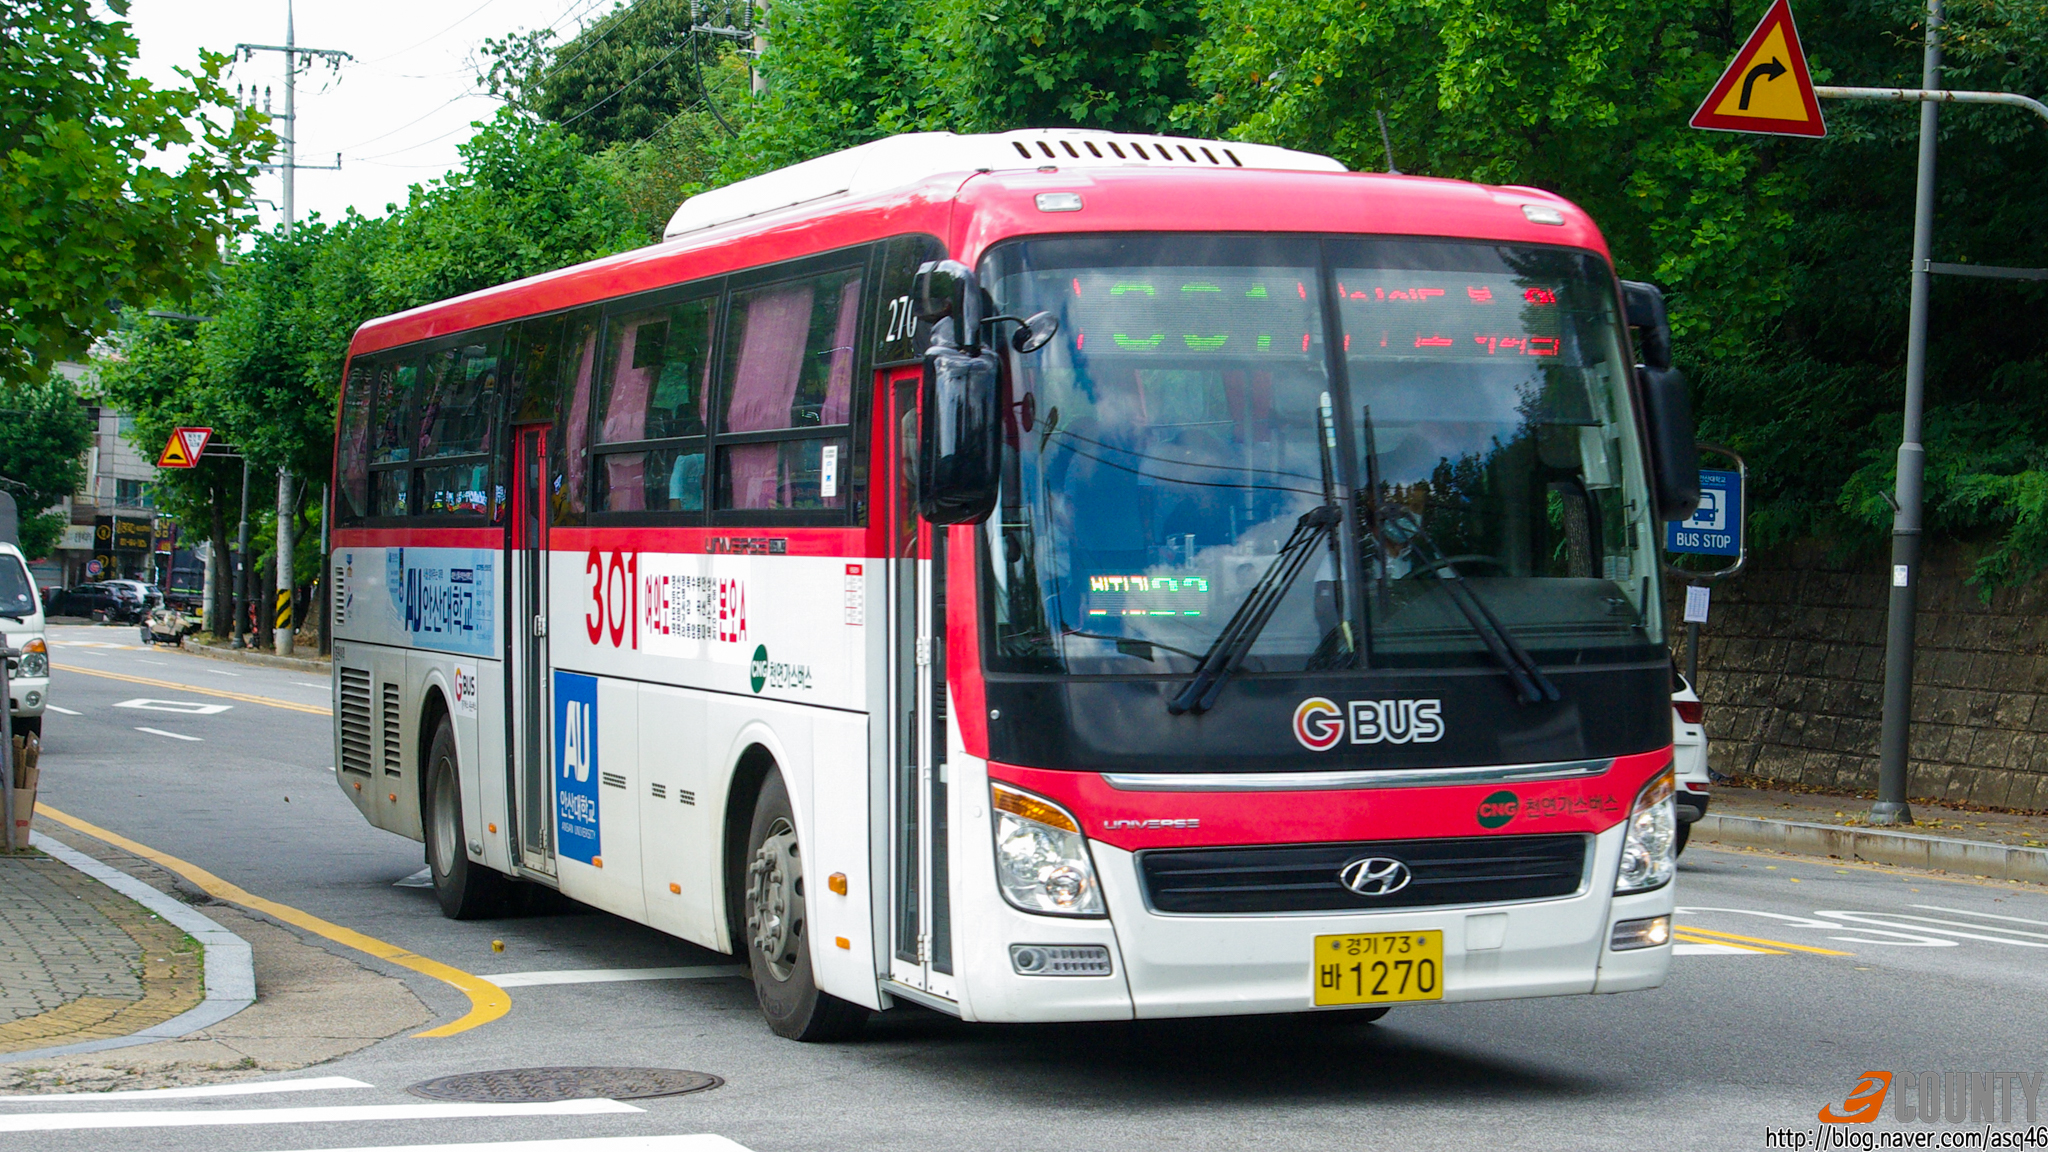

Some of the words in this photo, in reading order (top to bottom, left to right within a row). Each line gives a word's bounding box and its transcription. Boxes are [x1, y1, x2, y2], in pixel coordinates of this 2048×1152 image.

[1676, 532, 1700, 548] BUS
[1703, 533, 1731, 549] STOP
[405, 567, 422, 633] AU
[422, 584, 474, 636] 안산대학교
[585, 545, 638, 650] 301
[645, 573, 669, 635] 여의도
[751, 660, 768, 678] CNG
[769, 661, 813, 691] 천연가스버스
[563, 700, 590, 783] AU
[559, 790, 597, 825] 안산대학교
[1479, 801, 1518, 818] CNG
[1525, 794, 1619, 819] 천연가스버스
[1103, 818, 1200, 830] UNIVERSE
[1346, 937, 1378, 956] 경기
[1383, 936, 1412, 954] 73
[1321, 963, 1342, 990] 바
[1350, 958, 1436, 997] 1270
